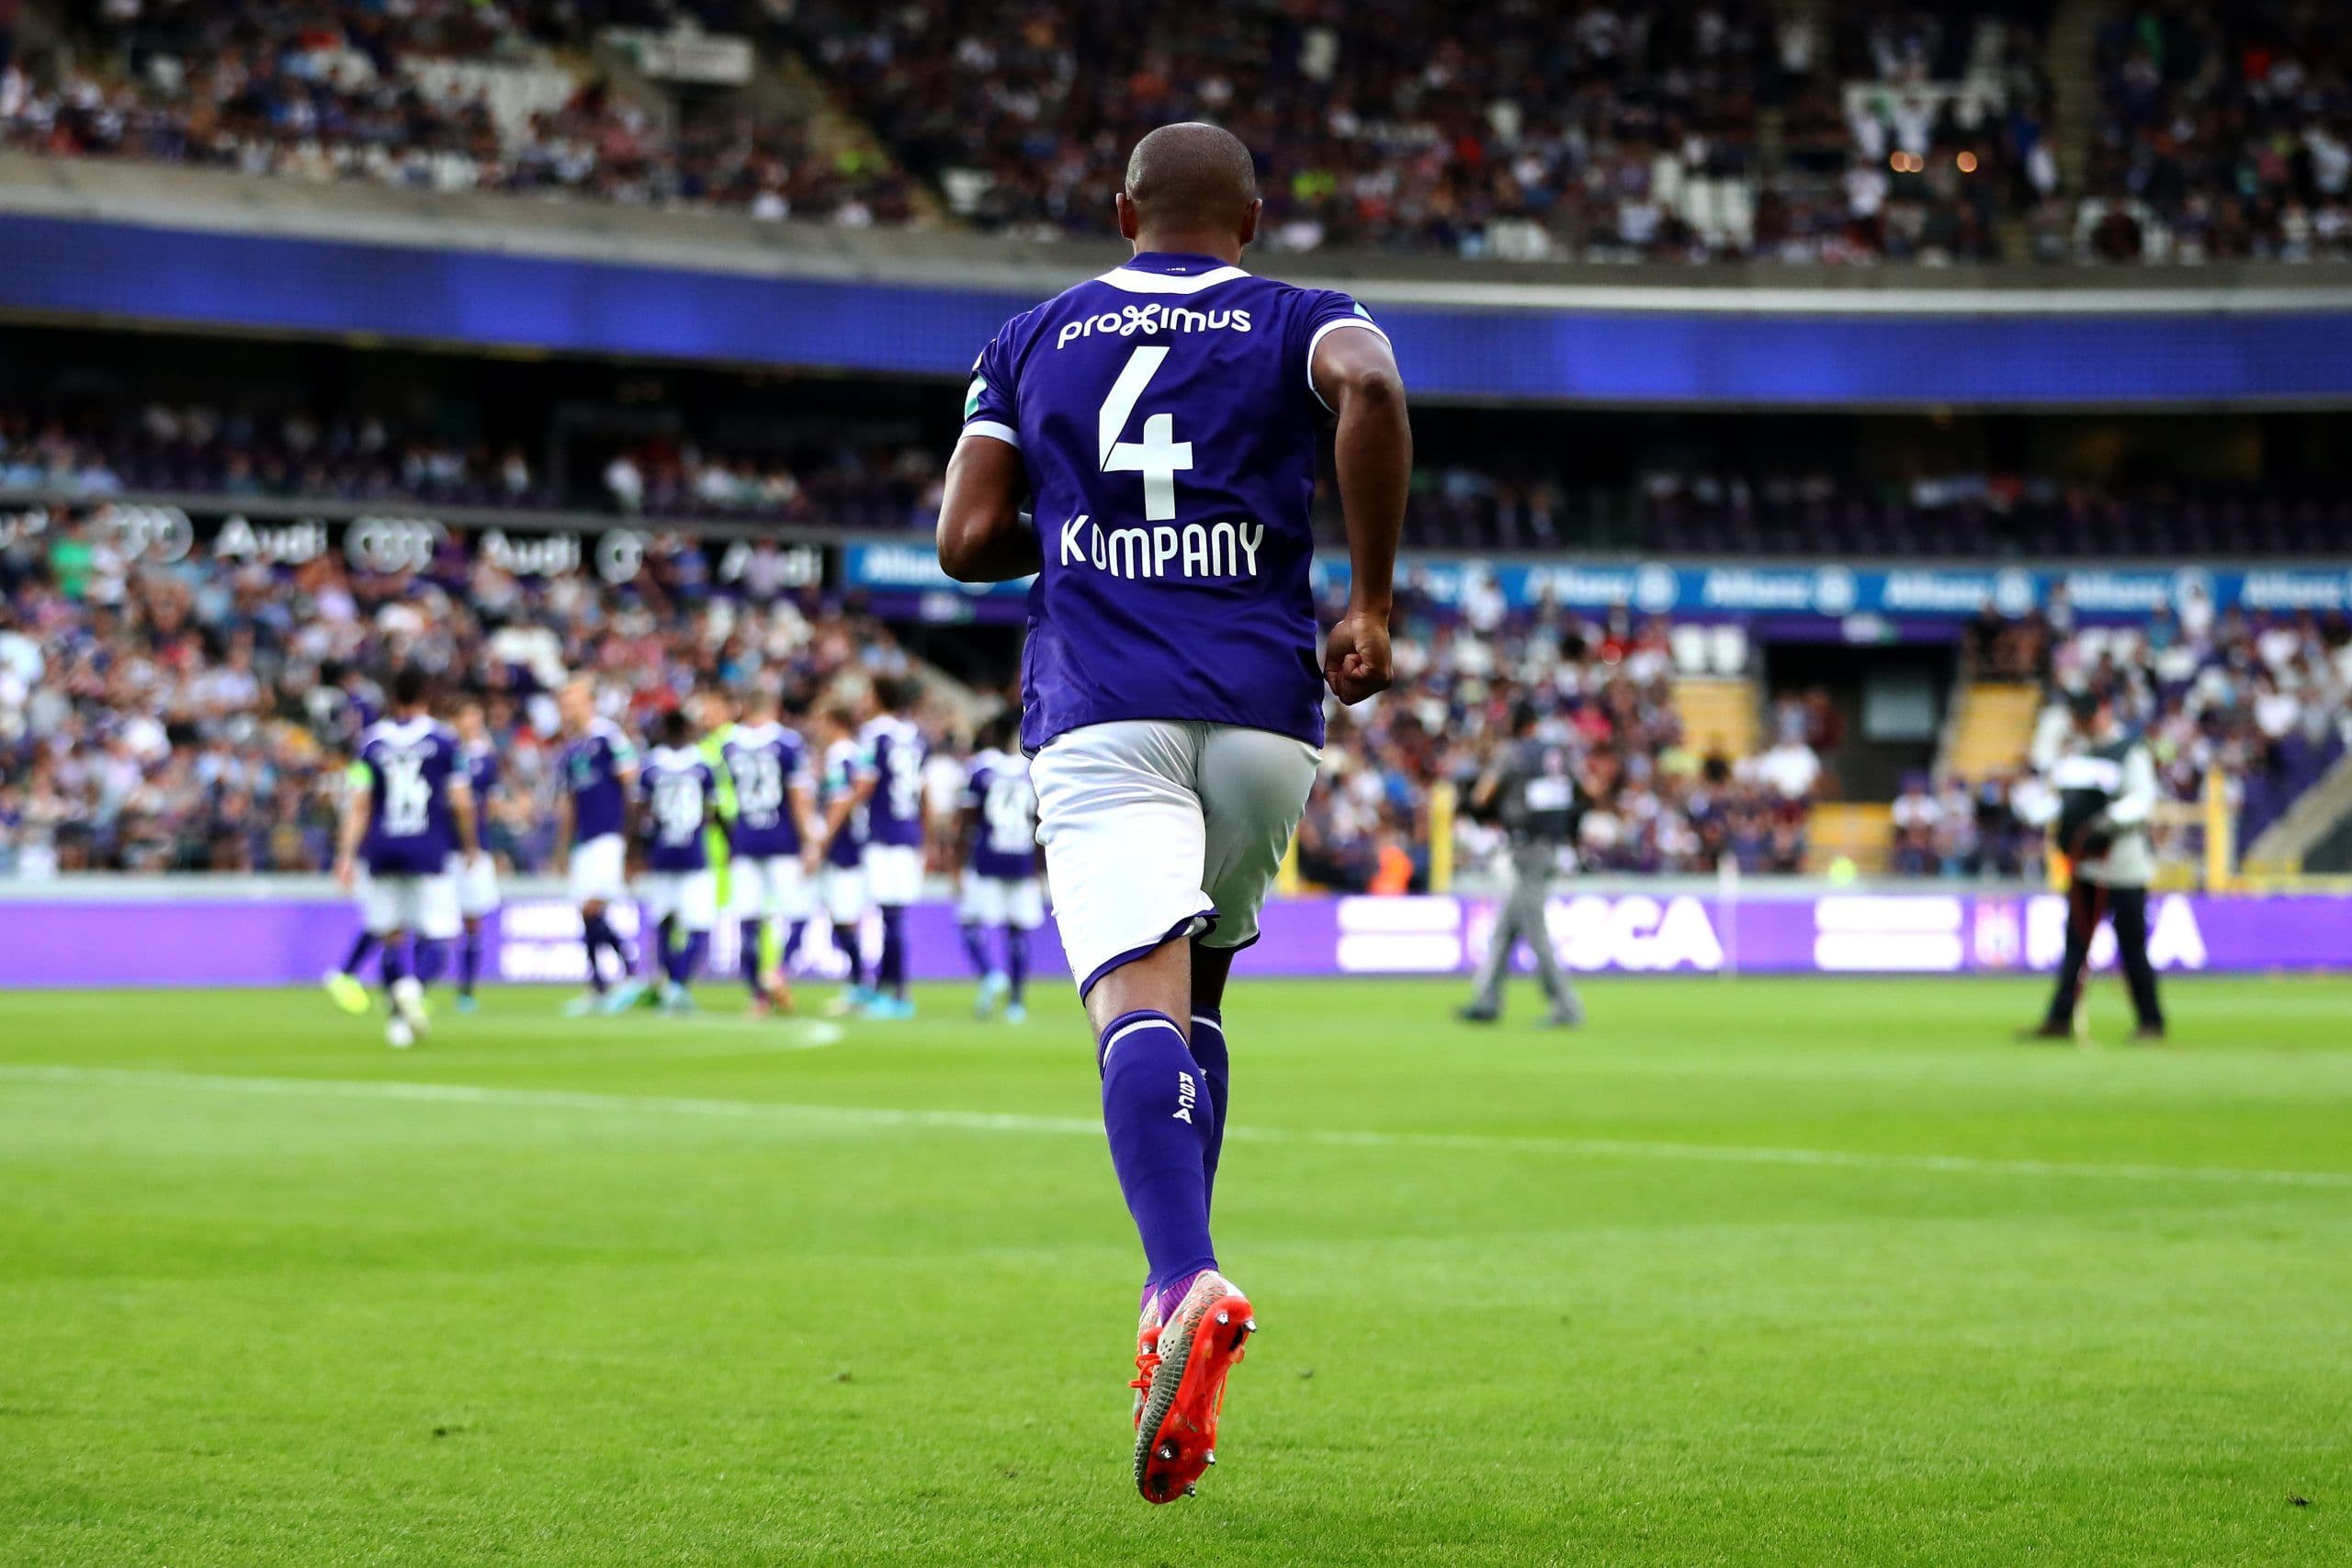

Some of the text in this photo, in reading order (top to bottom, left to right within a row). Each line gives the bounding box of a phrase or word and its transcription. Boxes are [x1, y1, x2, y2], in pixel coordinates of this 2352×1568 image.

[1057, 302, 1250, 349] proximus
[1099, 345, 1193, 521] 4
[214, 514, 327, 564] Audi
[1060, 513, 1264, 580] KOMPANY
[1518, 895, 1725, 971] SCA
[1172, 1070, 1196, 1124] RSCA
